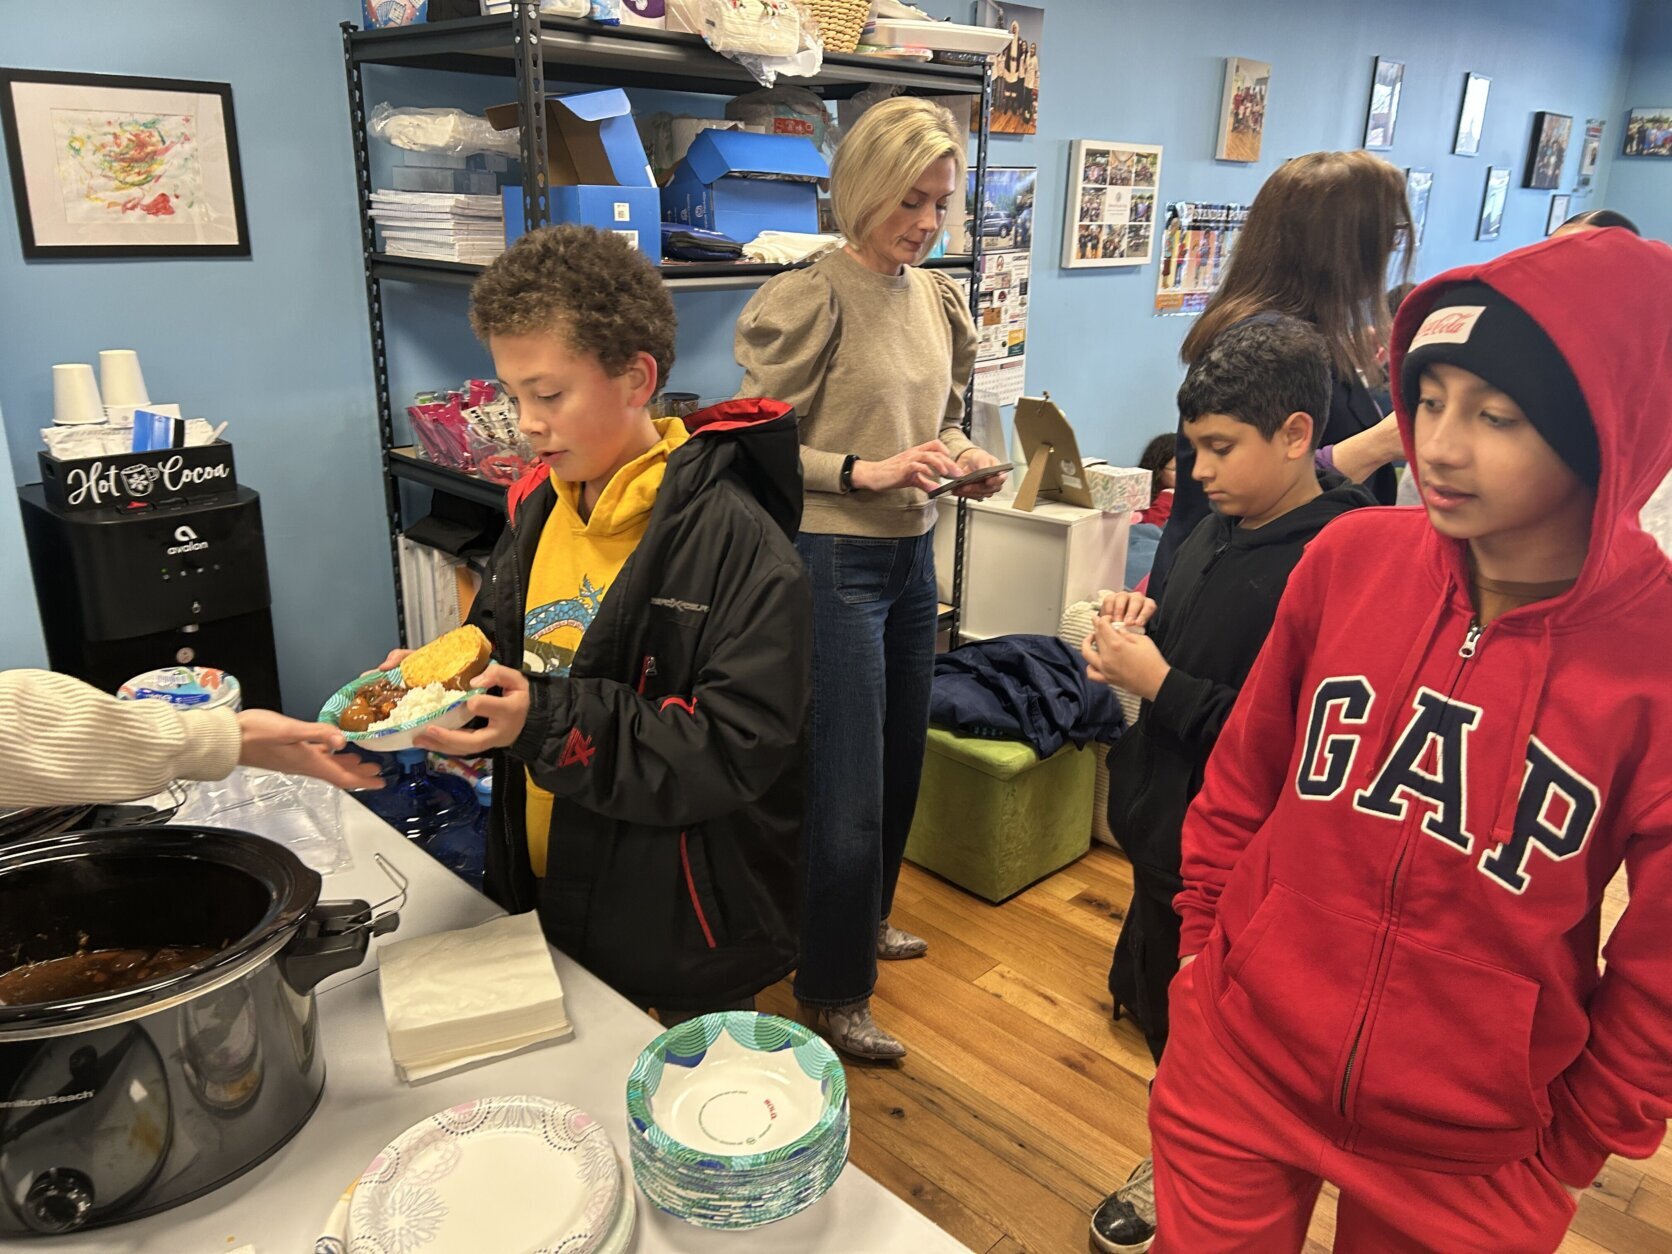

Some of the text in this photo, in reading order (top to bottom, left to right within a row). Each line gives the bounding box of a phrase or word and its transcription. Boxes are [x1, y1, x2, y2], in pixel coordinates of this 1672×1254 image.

[67, 455, 230, 505] Hot Cocoa
[166, 541, 209, 556] avalon
[1295, 675, 1601, 895] GAP
[48, 1089, 95, 1105] Beach
